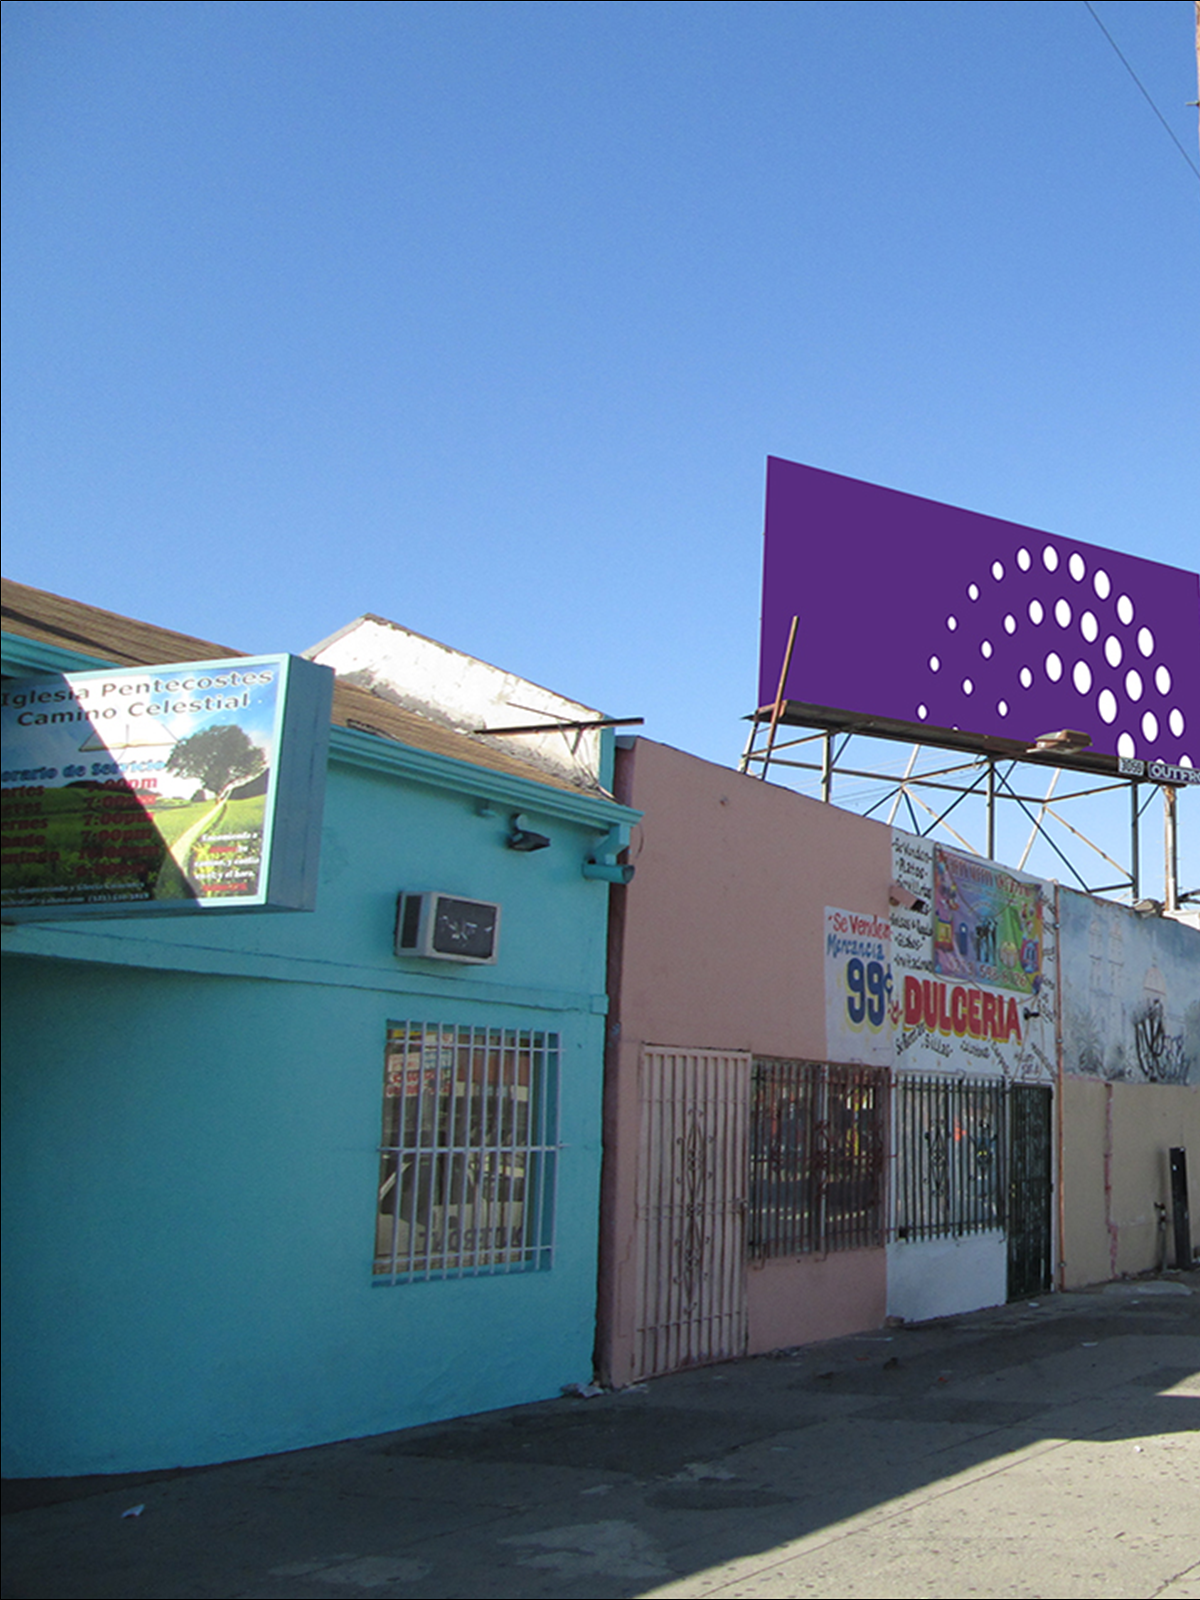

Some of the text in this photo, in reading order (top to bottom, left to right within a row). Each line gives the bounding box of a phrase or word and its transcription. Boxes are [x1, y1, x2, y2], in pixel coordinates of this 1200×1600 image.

[1, 669, 274, 709] Iglesia Pentecostes
[17, 693, 249, 727] Camino Celestial
[1, 764, 58, 782] orario
[62, 763, 87, 778] de
[1, 785, 44, 798] artes
[1, 812, 153, 831] ernes 7:00pm
[80, 829, 152, 844] 7:00pm
[904, 974, 1023, 1042] DULCERIA
